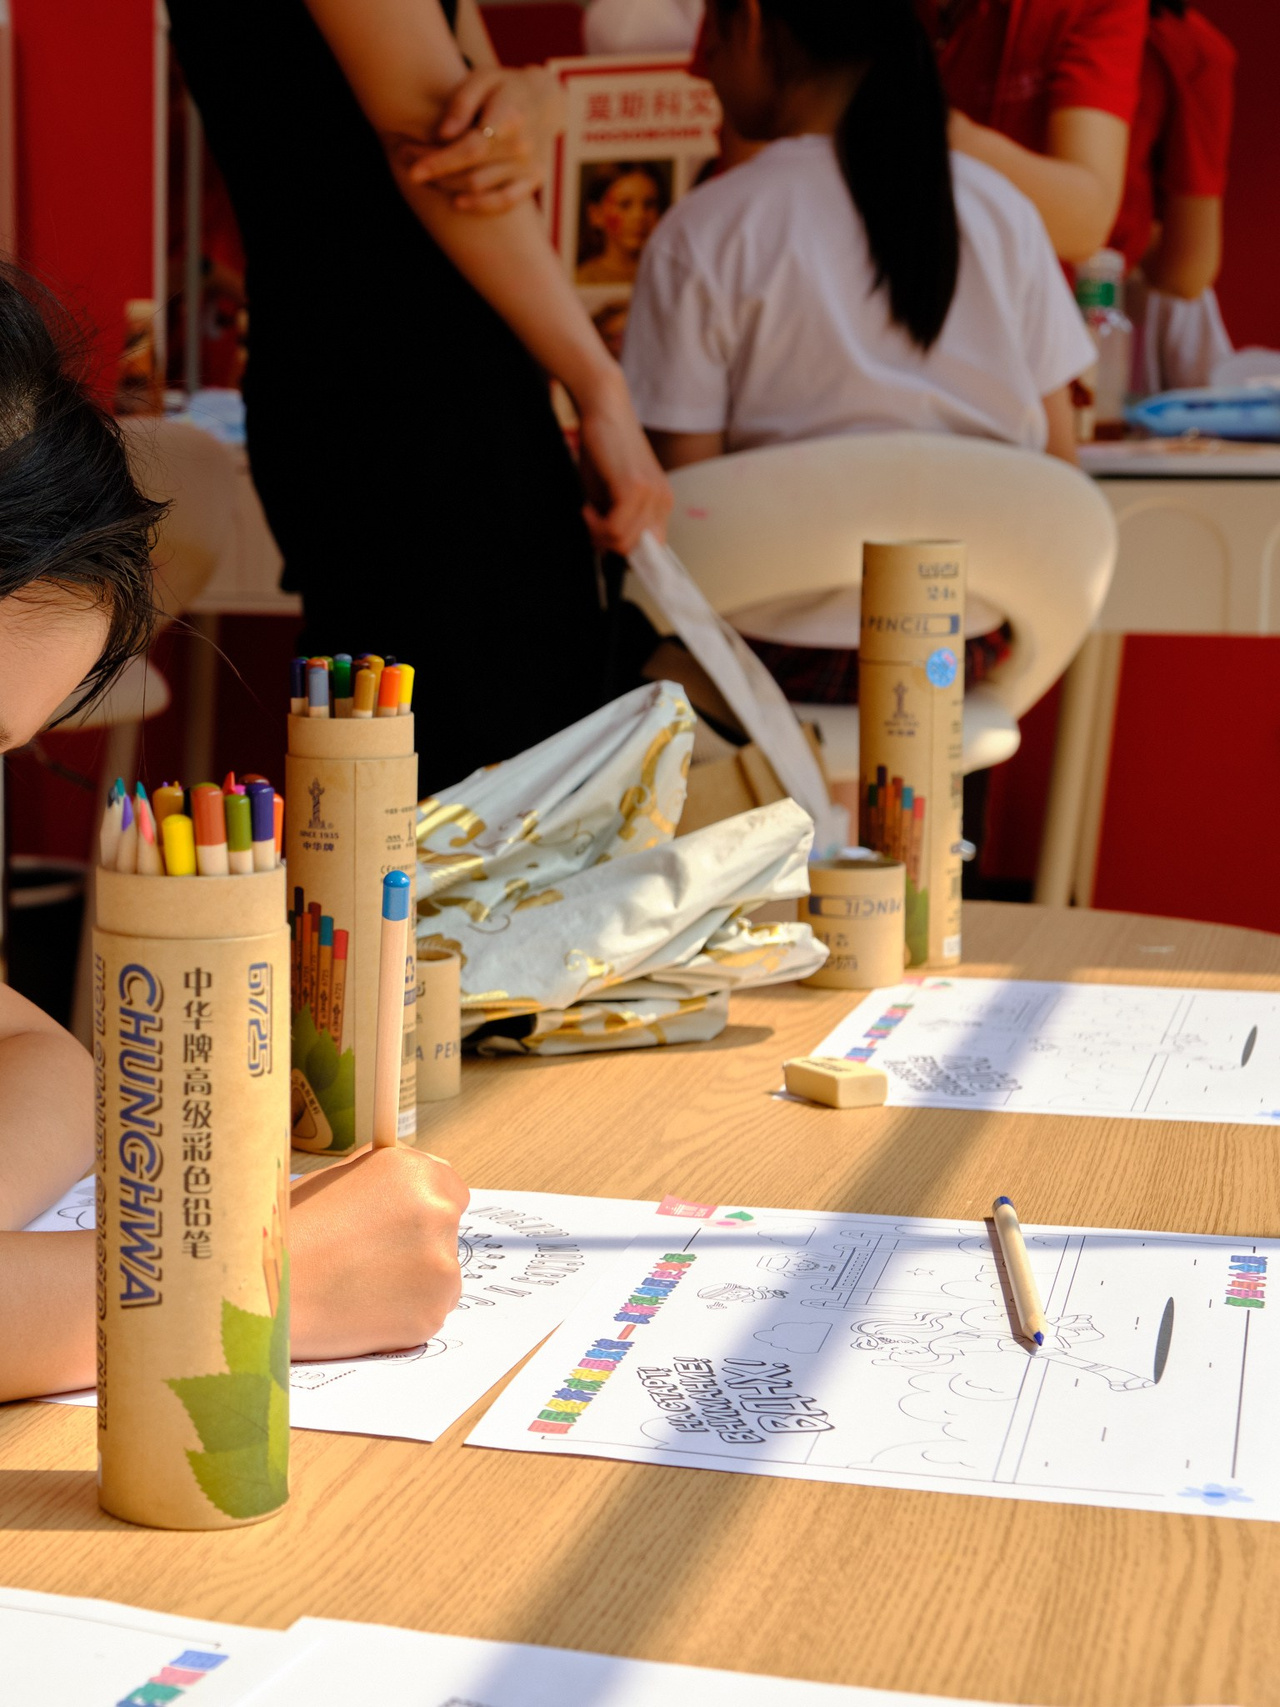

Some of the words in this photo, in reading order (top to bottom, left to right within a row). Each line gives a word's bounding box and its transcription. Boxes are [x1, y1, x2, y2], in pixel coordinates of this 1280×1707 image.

[119, 963, 164, 1309] CHUNGHWA
[182, 966, 213, 1260] 中华牌高级彩色铅笔
[637, 1366, 692, 1412] СТАРТ!
[665, 1411, 710, 1433] НА
[673, 1356, 766, 1444] ВНИМАНИЕ!
[721, 1357, 836, 1434] ВДНХ!
